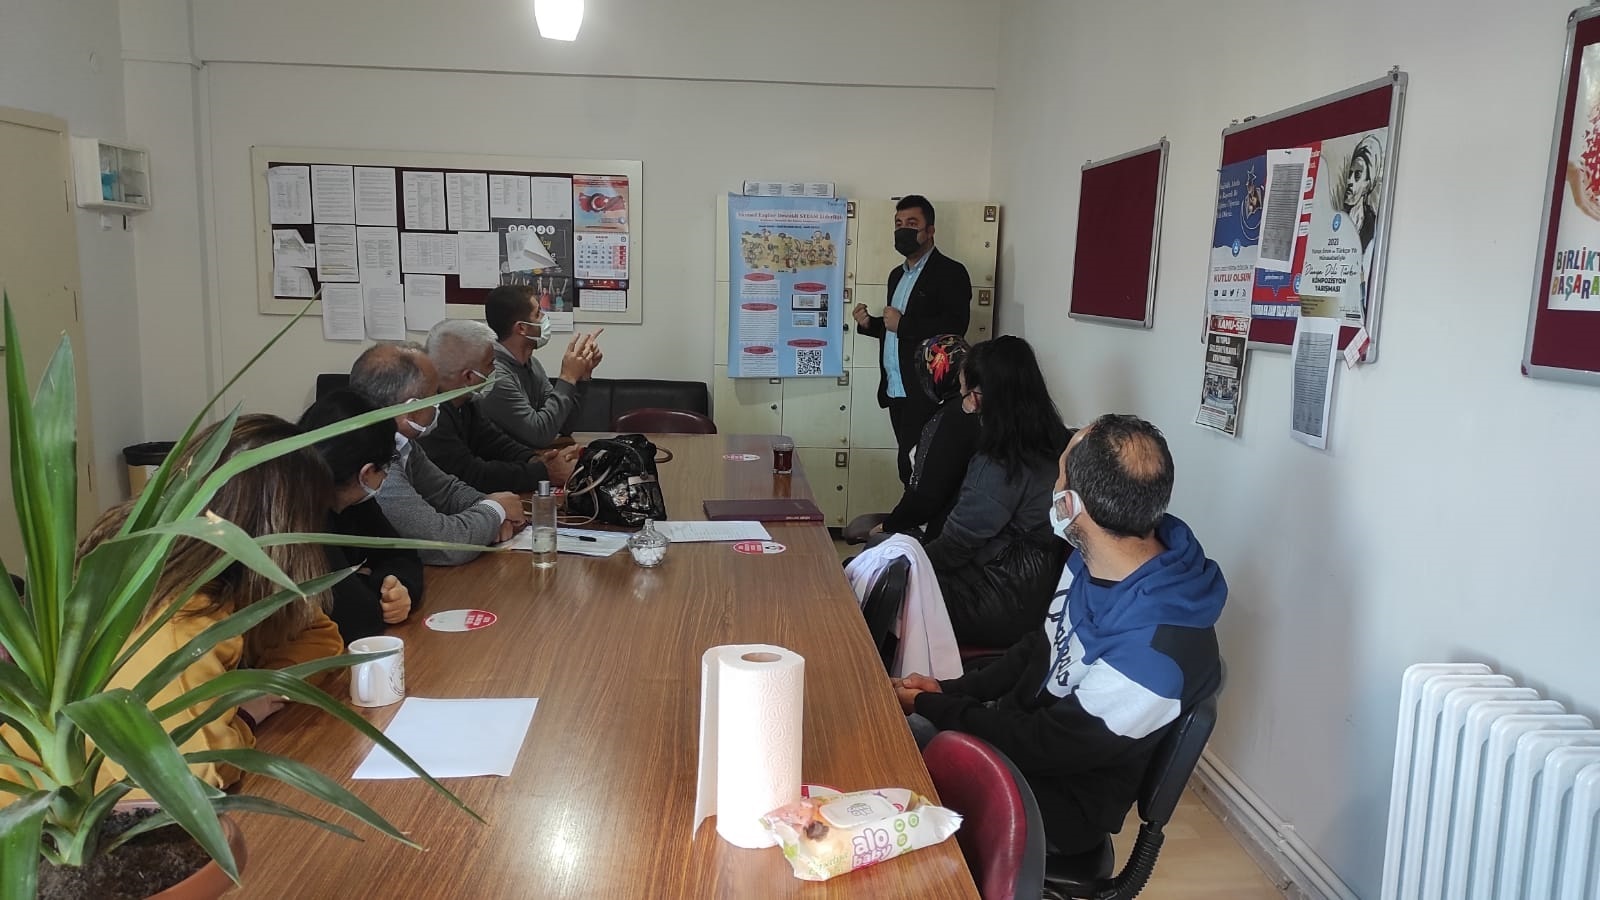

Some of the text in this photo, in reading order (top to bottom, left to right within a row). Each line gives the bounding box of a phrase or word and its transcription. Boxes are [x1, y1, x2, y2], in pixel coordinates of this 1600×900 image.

[1214, 272, 1251, 283] KUTLU OLSUN
[1217, 319, 1248, 332] KAMU-SEN
[852, 828, 889, 855] alo
[853, 844, 893, 868] baby
